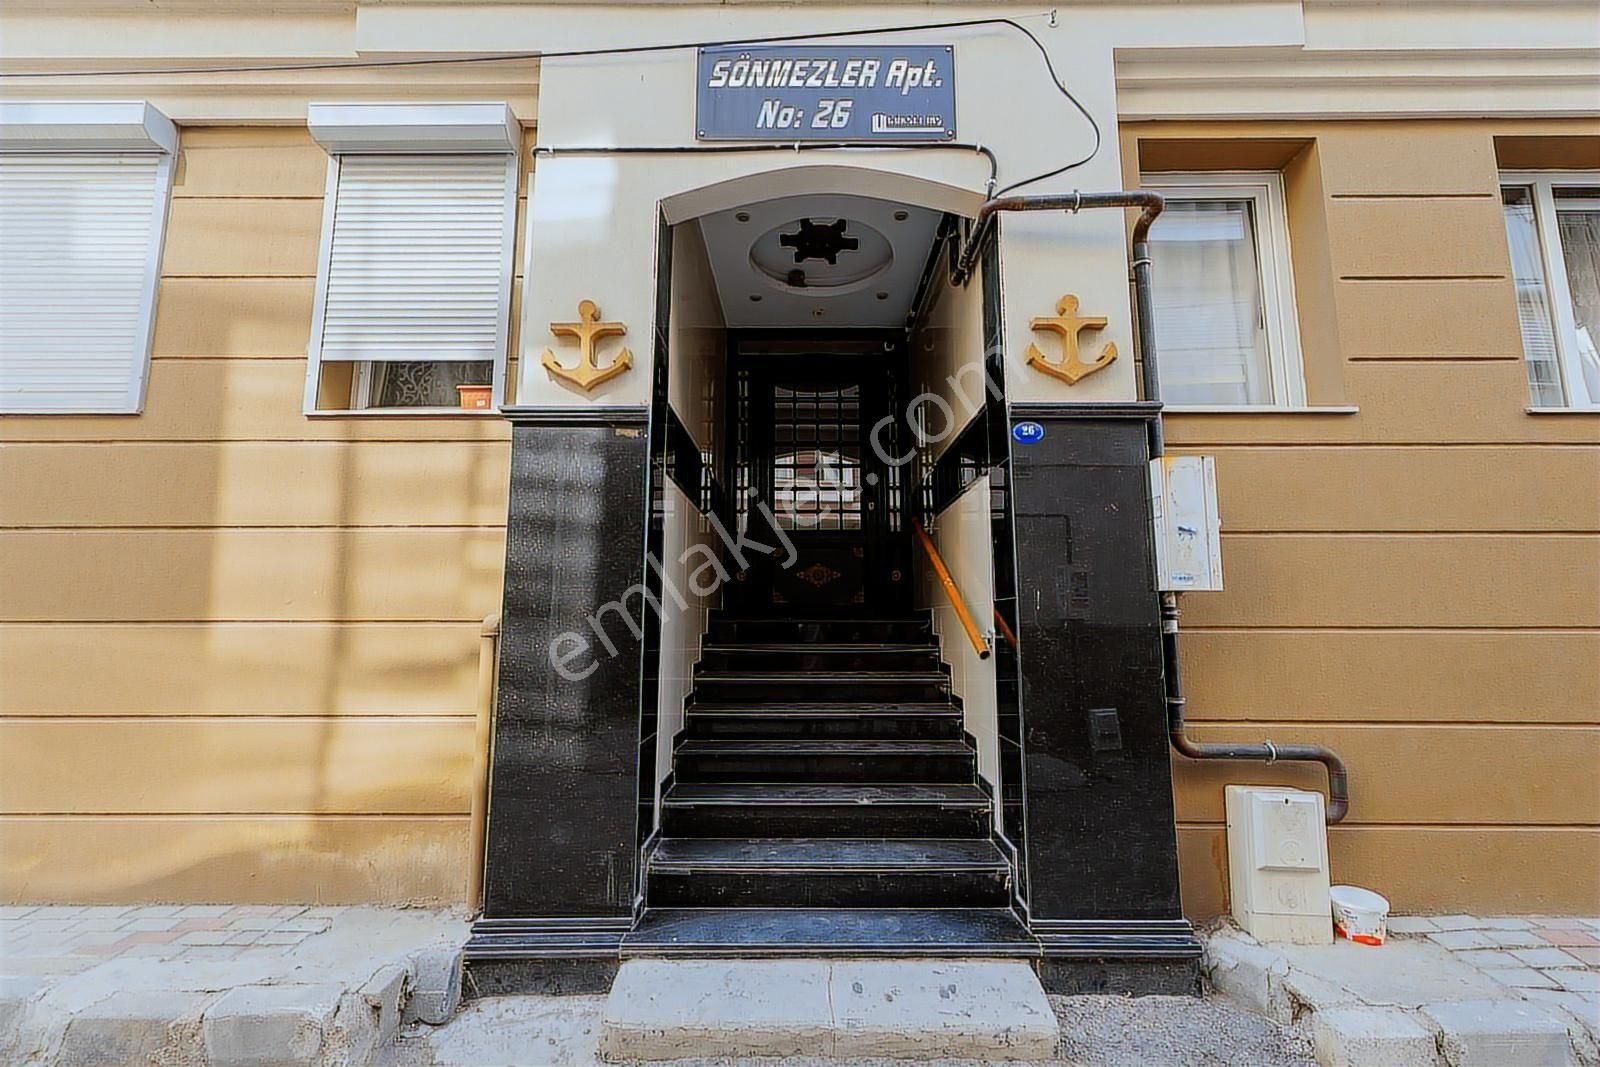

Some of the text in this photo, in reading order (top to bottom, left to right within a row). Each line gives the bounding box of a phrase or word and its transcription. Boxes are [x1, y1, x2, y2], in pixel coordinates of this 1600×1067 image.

[708, 53, 942, 96] SÖNMEZLER Apt.
[756, 99, 854, 129] No: 26
[1021, 425, 1035, 436] 26
